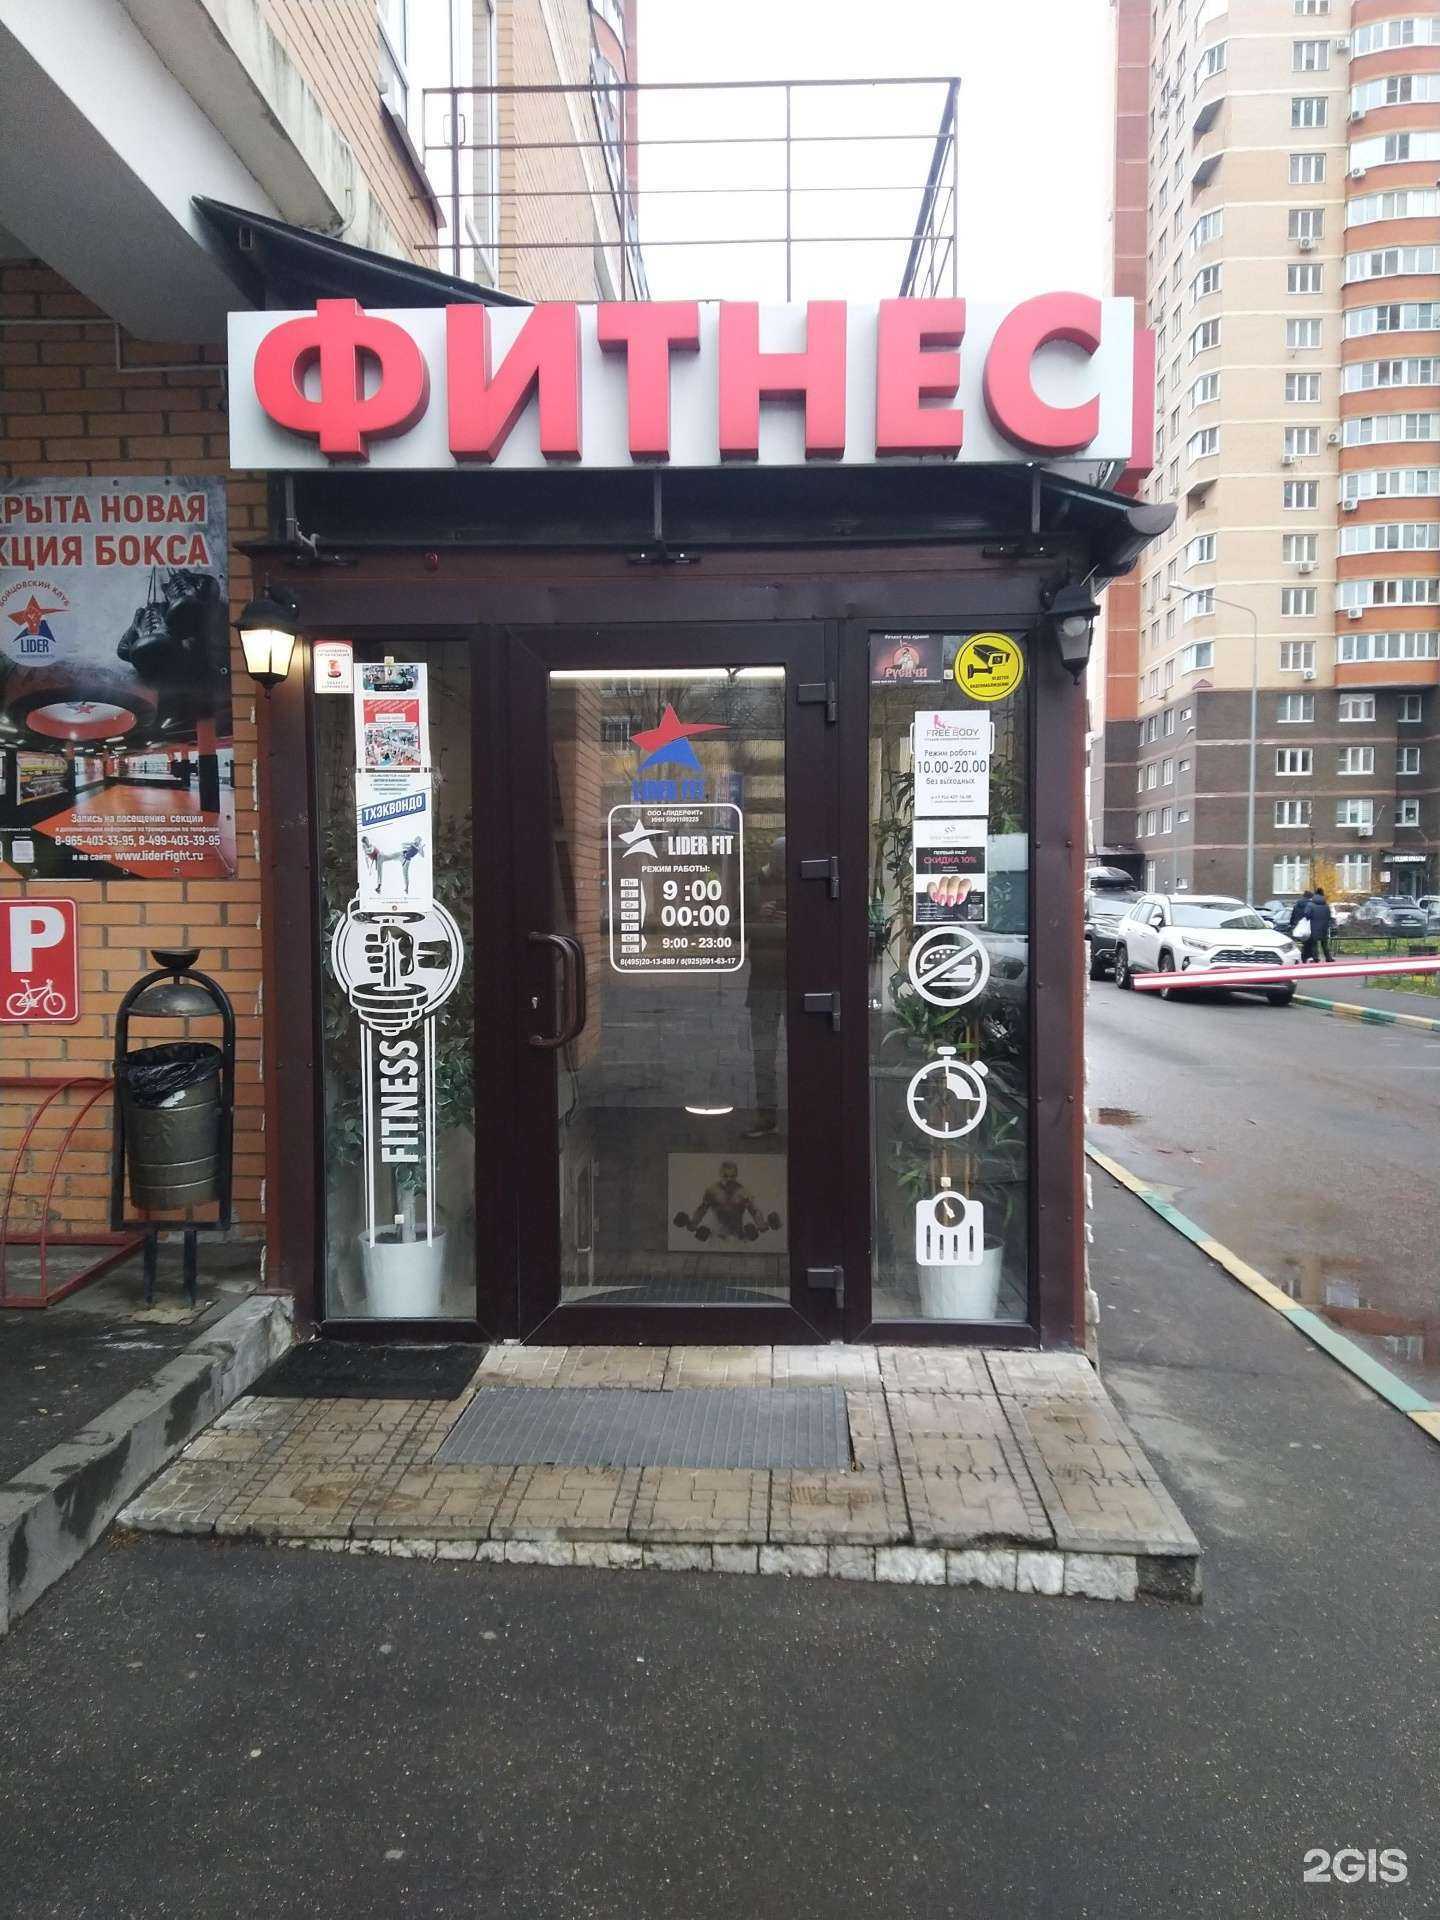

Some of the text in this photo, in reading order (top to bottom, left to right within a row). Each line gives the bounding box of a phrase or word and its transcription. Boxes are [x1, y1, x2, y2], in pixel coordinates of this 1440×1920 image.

[253, 290, 1103, 464] ФИТНЕС
[0, 494, 206, 524] РЫТА НОВАЯ
[95, 534, 210, 566] БОКСА
[20, 639, 50, 653] LIDER
[926, 728, 951, 737] FREE
[917, 759, 987, 774] 10.00-20.00
[71, 813, 103, 823] Запись
[116, 815, 166, 824] посещение
[170, 815, 204, 824] секции
[363, 796, 423, 821] ТХЭКВОНДО
[667, 835, 734, 856] LIDER FIT
[641, 865, 711, 873] РЕЖИМ РАБОТЫ:
[661, 904, 730, 927] 00:00
[9, 906, 66, 973] P
[662, 937, 689, 949] 9:00
[698, 937, 732, 949] 23:00
[378, 1039, 419, 1163] FITNESS
